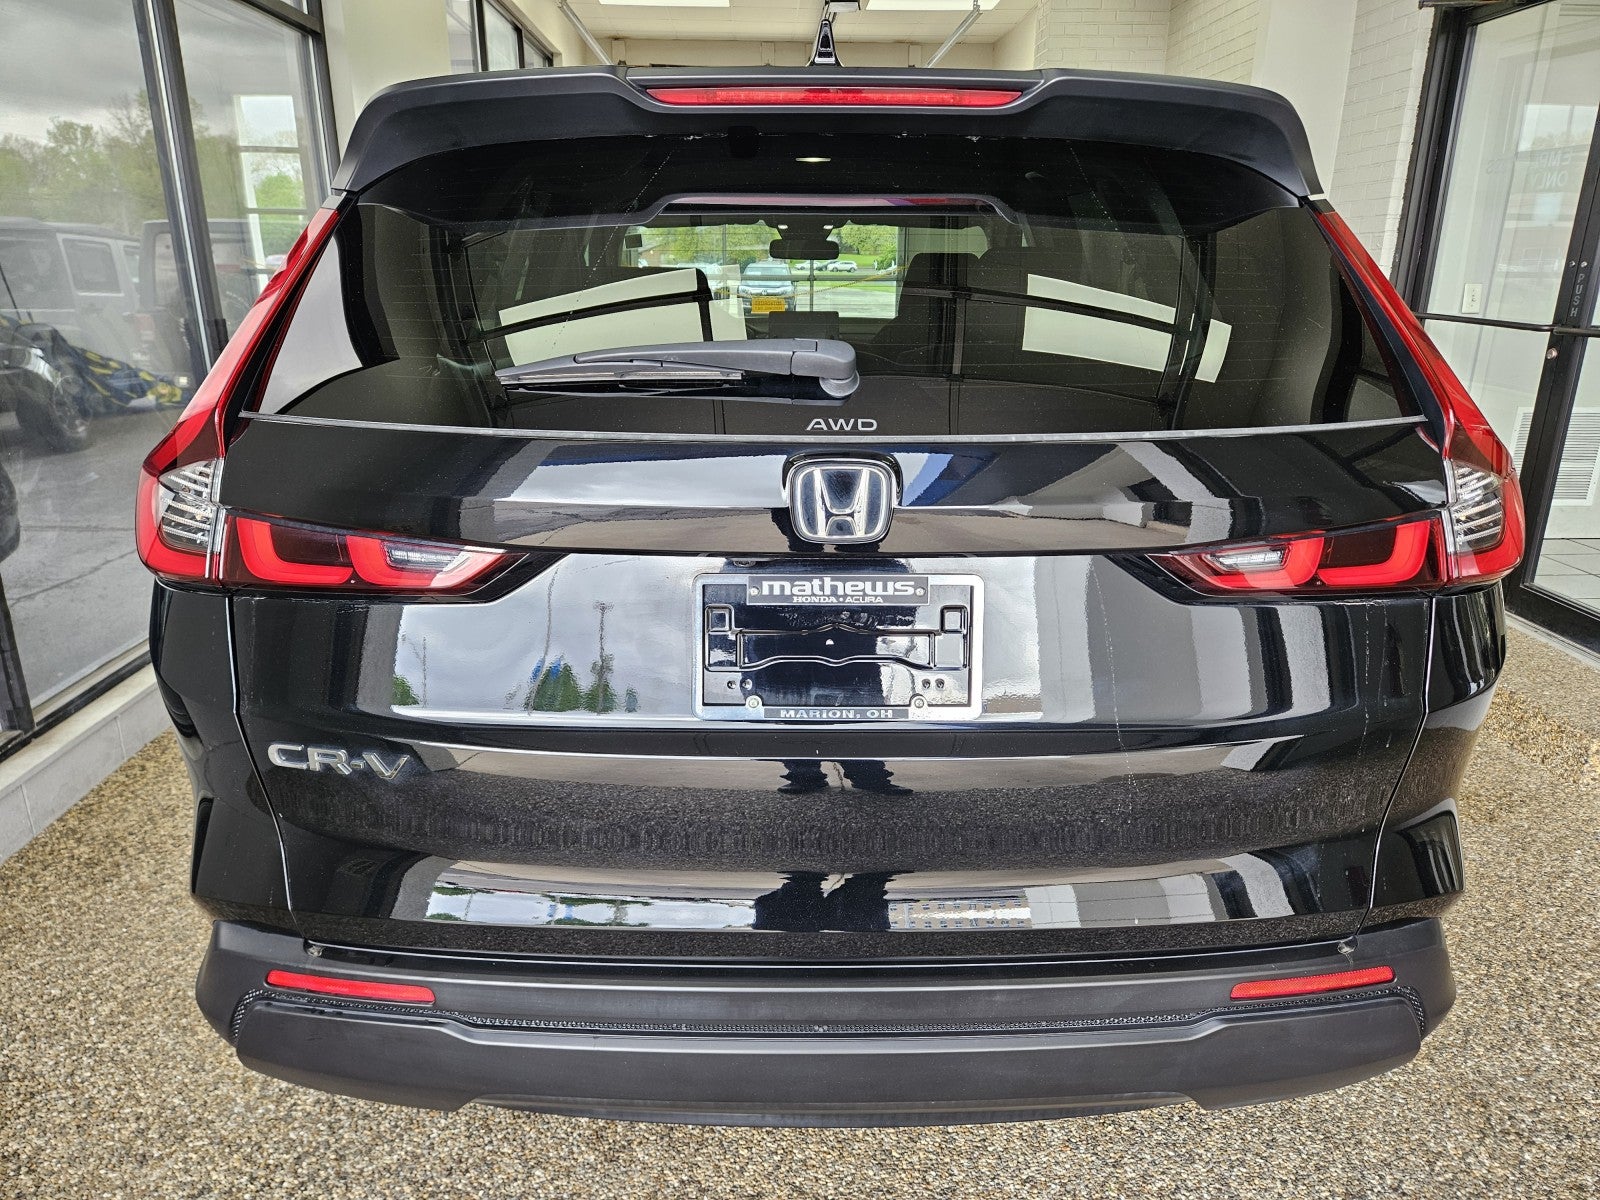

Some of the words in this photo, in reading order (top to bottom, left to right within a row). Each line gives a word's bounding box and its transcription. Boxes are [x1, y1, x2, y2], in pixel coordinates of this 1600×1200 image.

[1570, 273, 1586, 317] PUSH
[806, 418, 878, 431] AWD
[762, 577, 915, 596] mathews
[780, 709, 861, 719] MARION,
[866, 709, 893, 718] OH
[267, 741, 411, 780] CR-V
